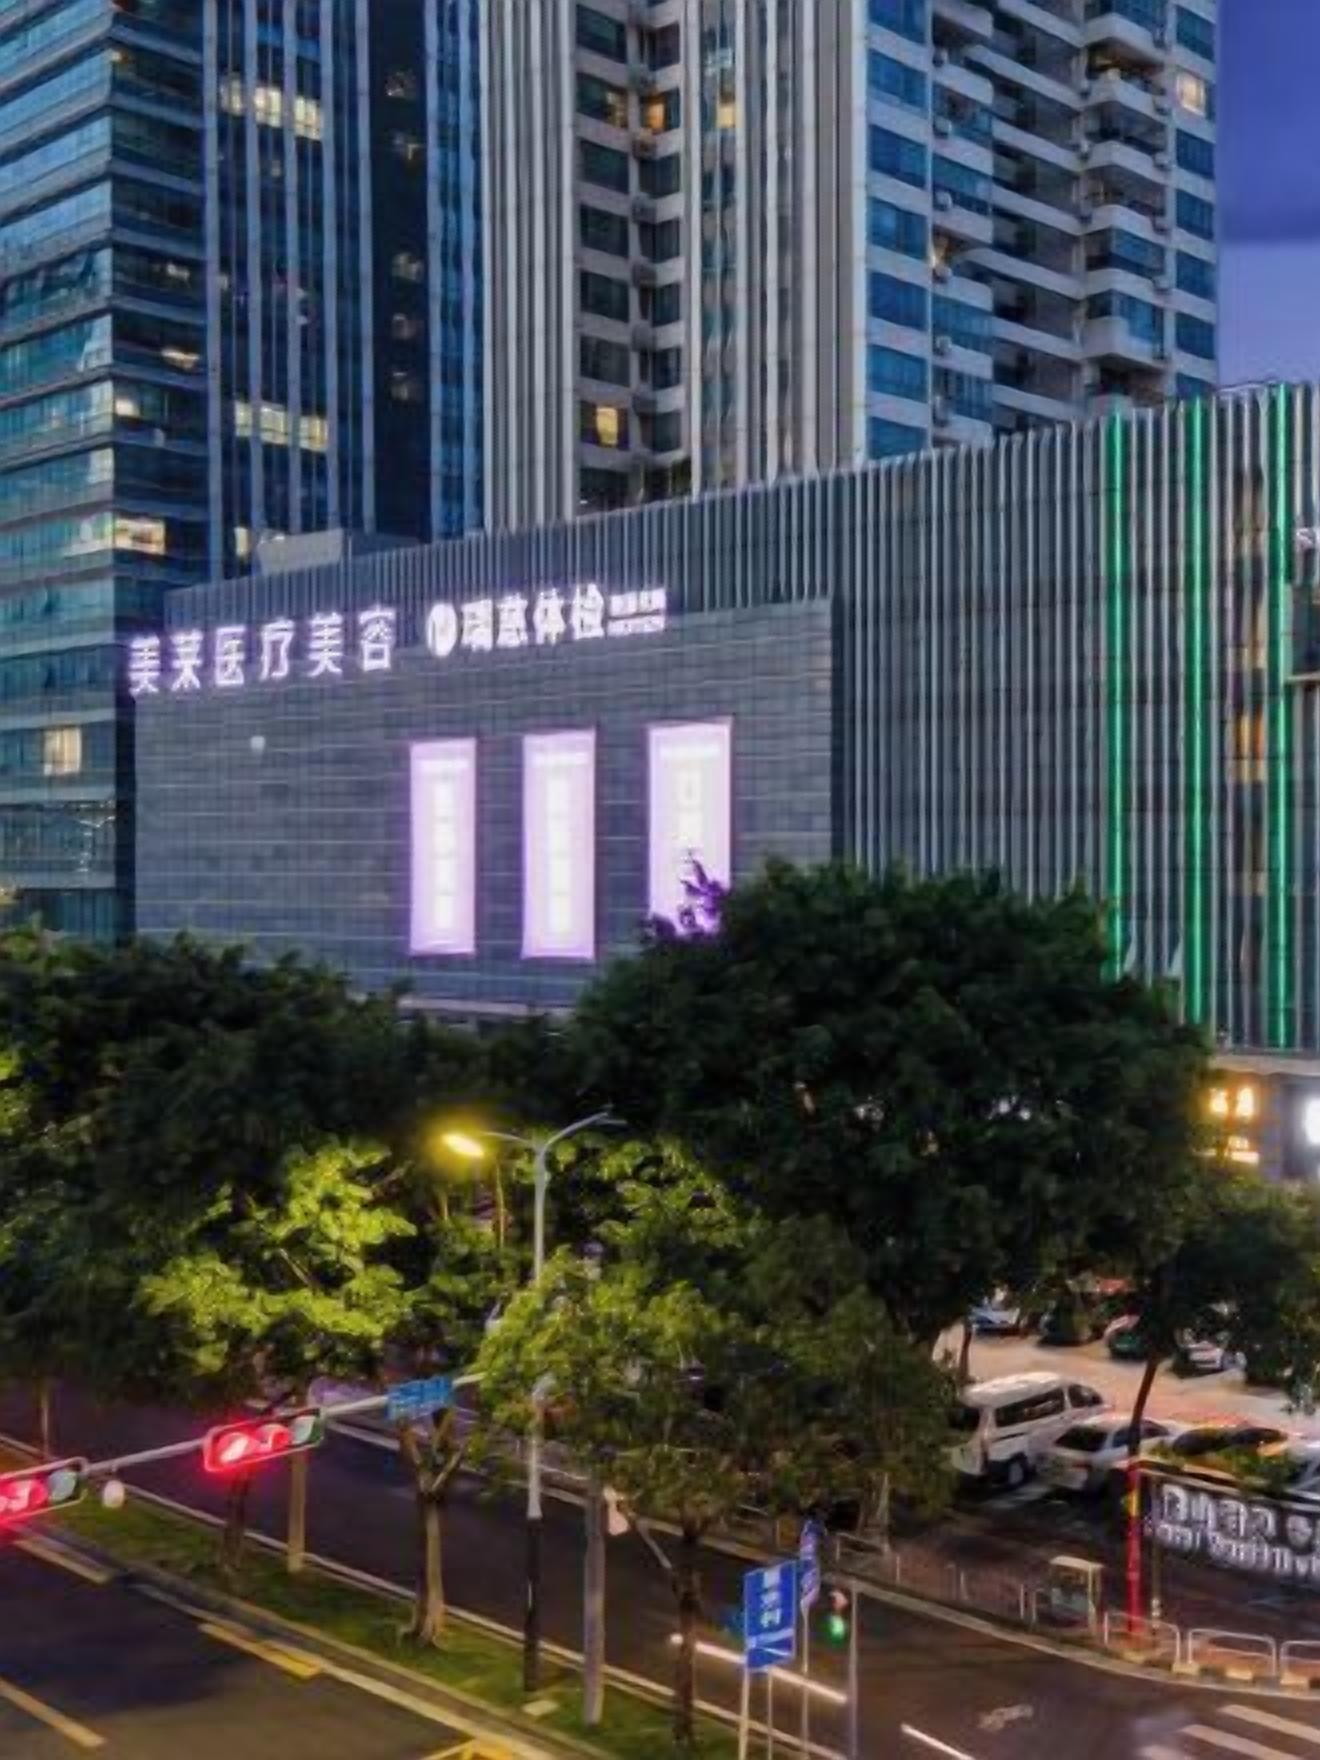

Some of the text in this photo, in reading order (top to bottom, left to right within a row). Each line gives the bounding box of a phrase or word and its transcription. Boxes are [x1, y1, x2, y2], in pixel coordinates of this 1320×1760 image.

[129, 605, 396, 695] 美莱医疗美容
